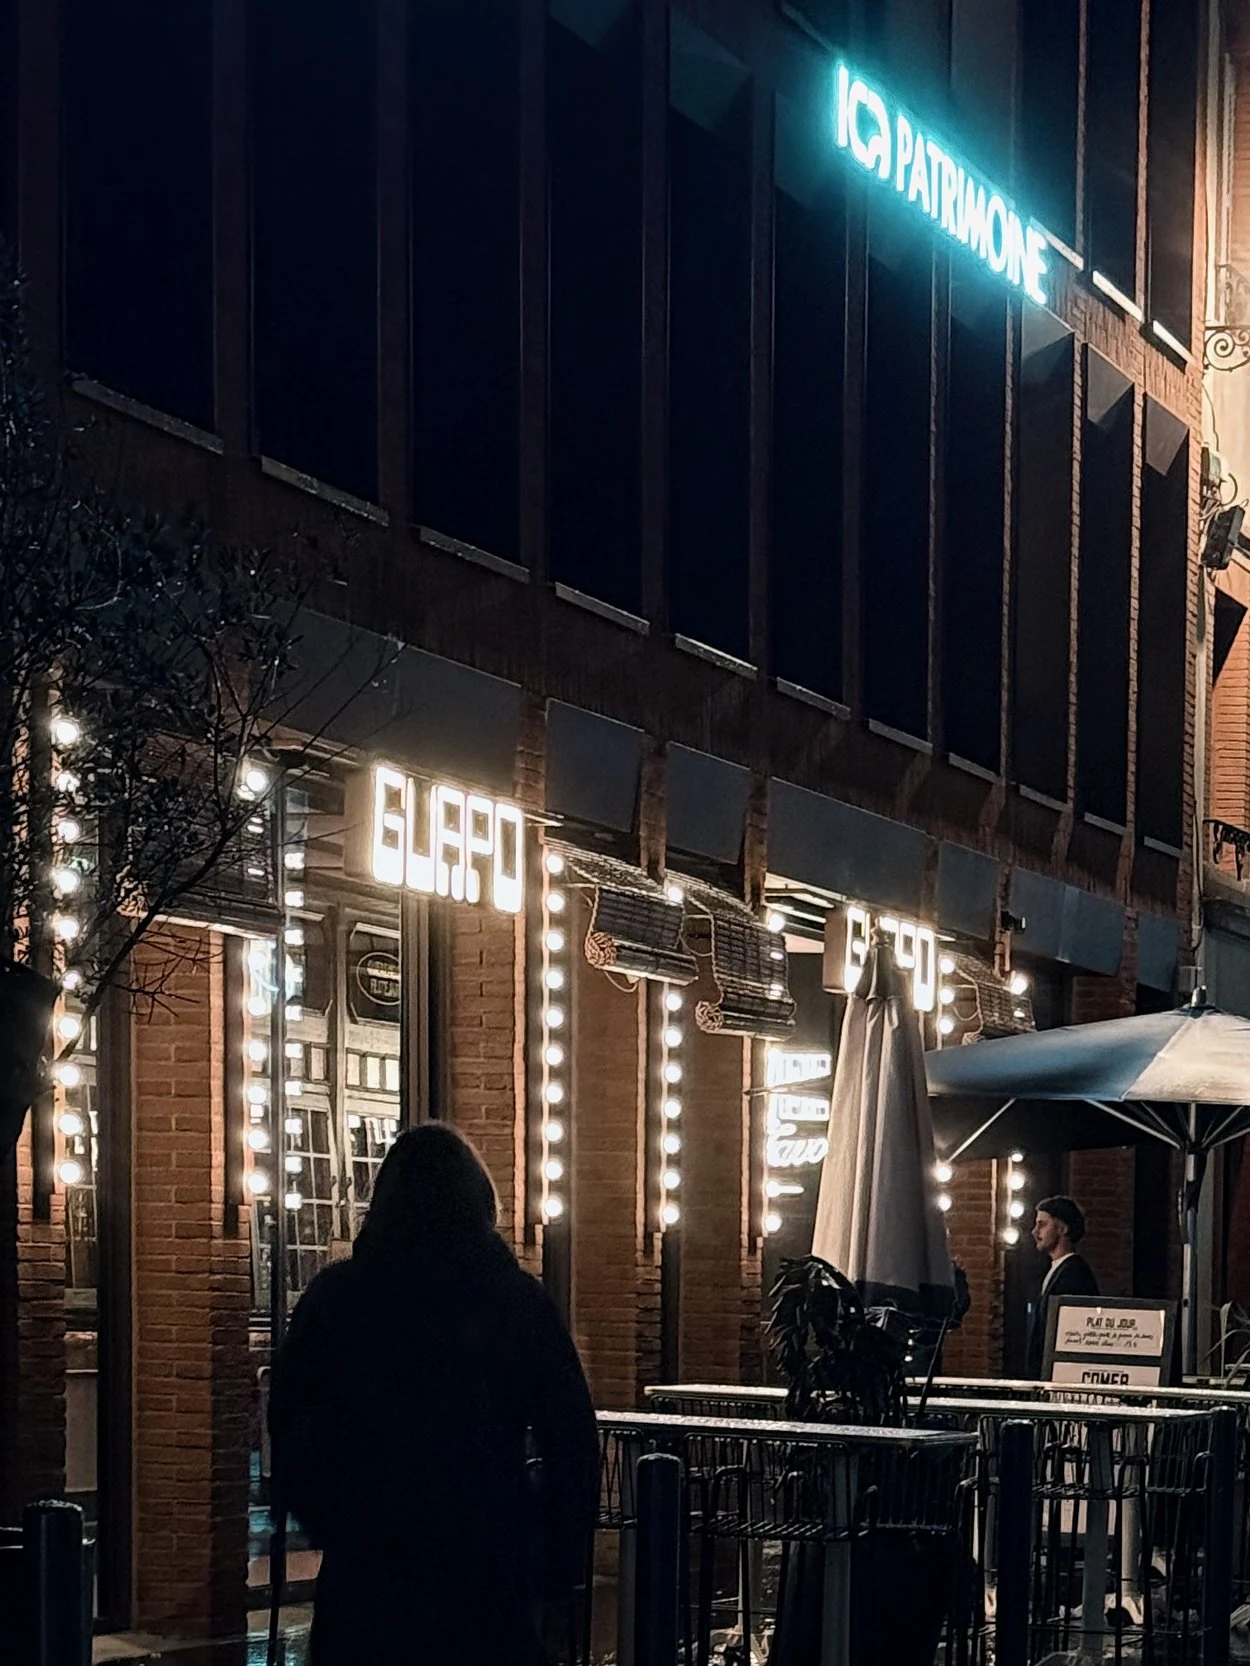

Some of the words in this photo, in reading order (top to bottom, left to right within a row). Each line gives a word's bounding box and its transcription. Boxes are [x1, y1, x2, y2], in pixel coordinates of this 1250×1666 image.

[896, 113, 1048, 306] PATRIMOINE
[372, 765, 524, 915] GUAPO
[1086, 1316, 1103, 1328] PLAT
[1105, 1317, 1115, 1328] DU
[1117, 1318, 1136, 1329] JOUR
